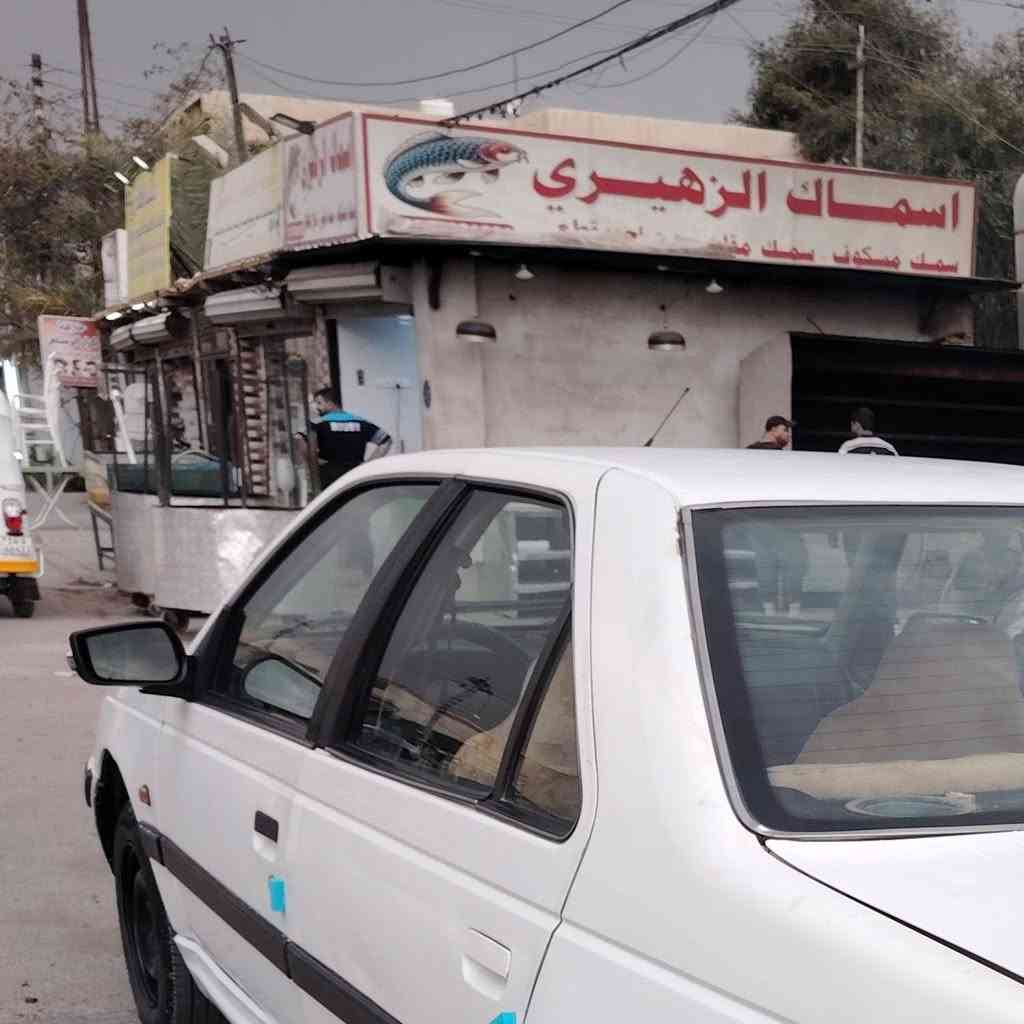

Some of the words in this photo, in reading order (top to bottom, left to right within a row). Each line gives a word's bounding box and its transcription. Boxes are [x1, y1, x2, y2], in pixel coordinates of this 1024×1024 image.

[532, 156, 768, 218] الزهيري
[785, 178, 960, 232] اسماك
[761, 239, 816, 262] سمك
[910, 252, 959, 273] سمك
